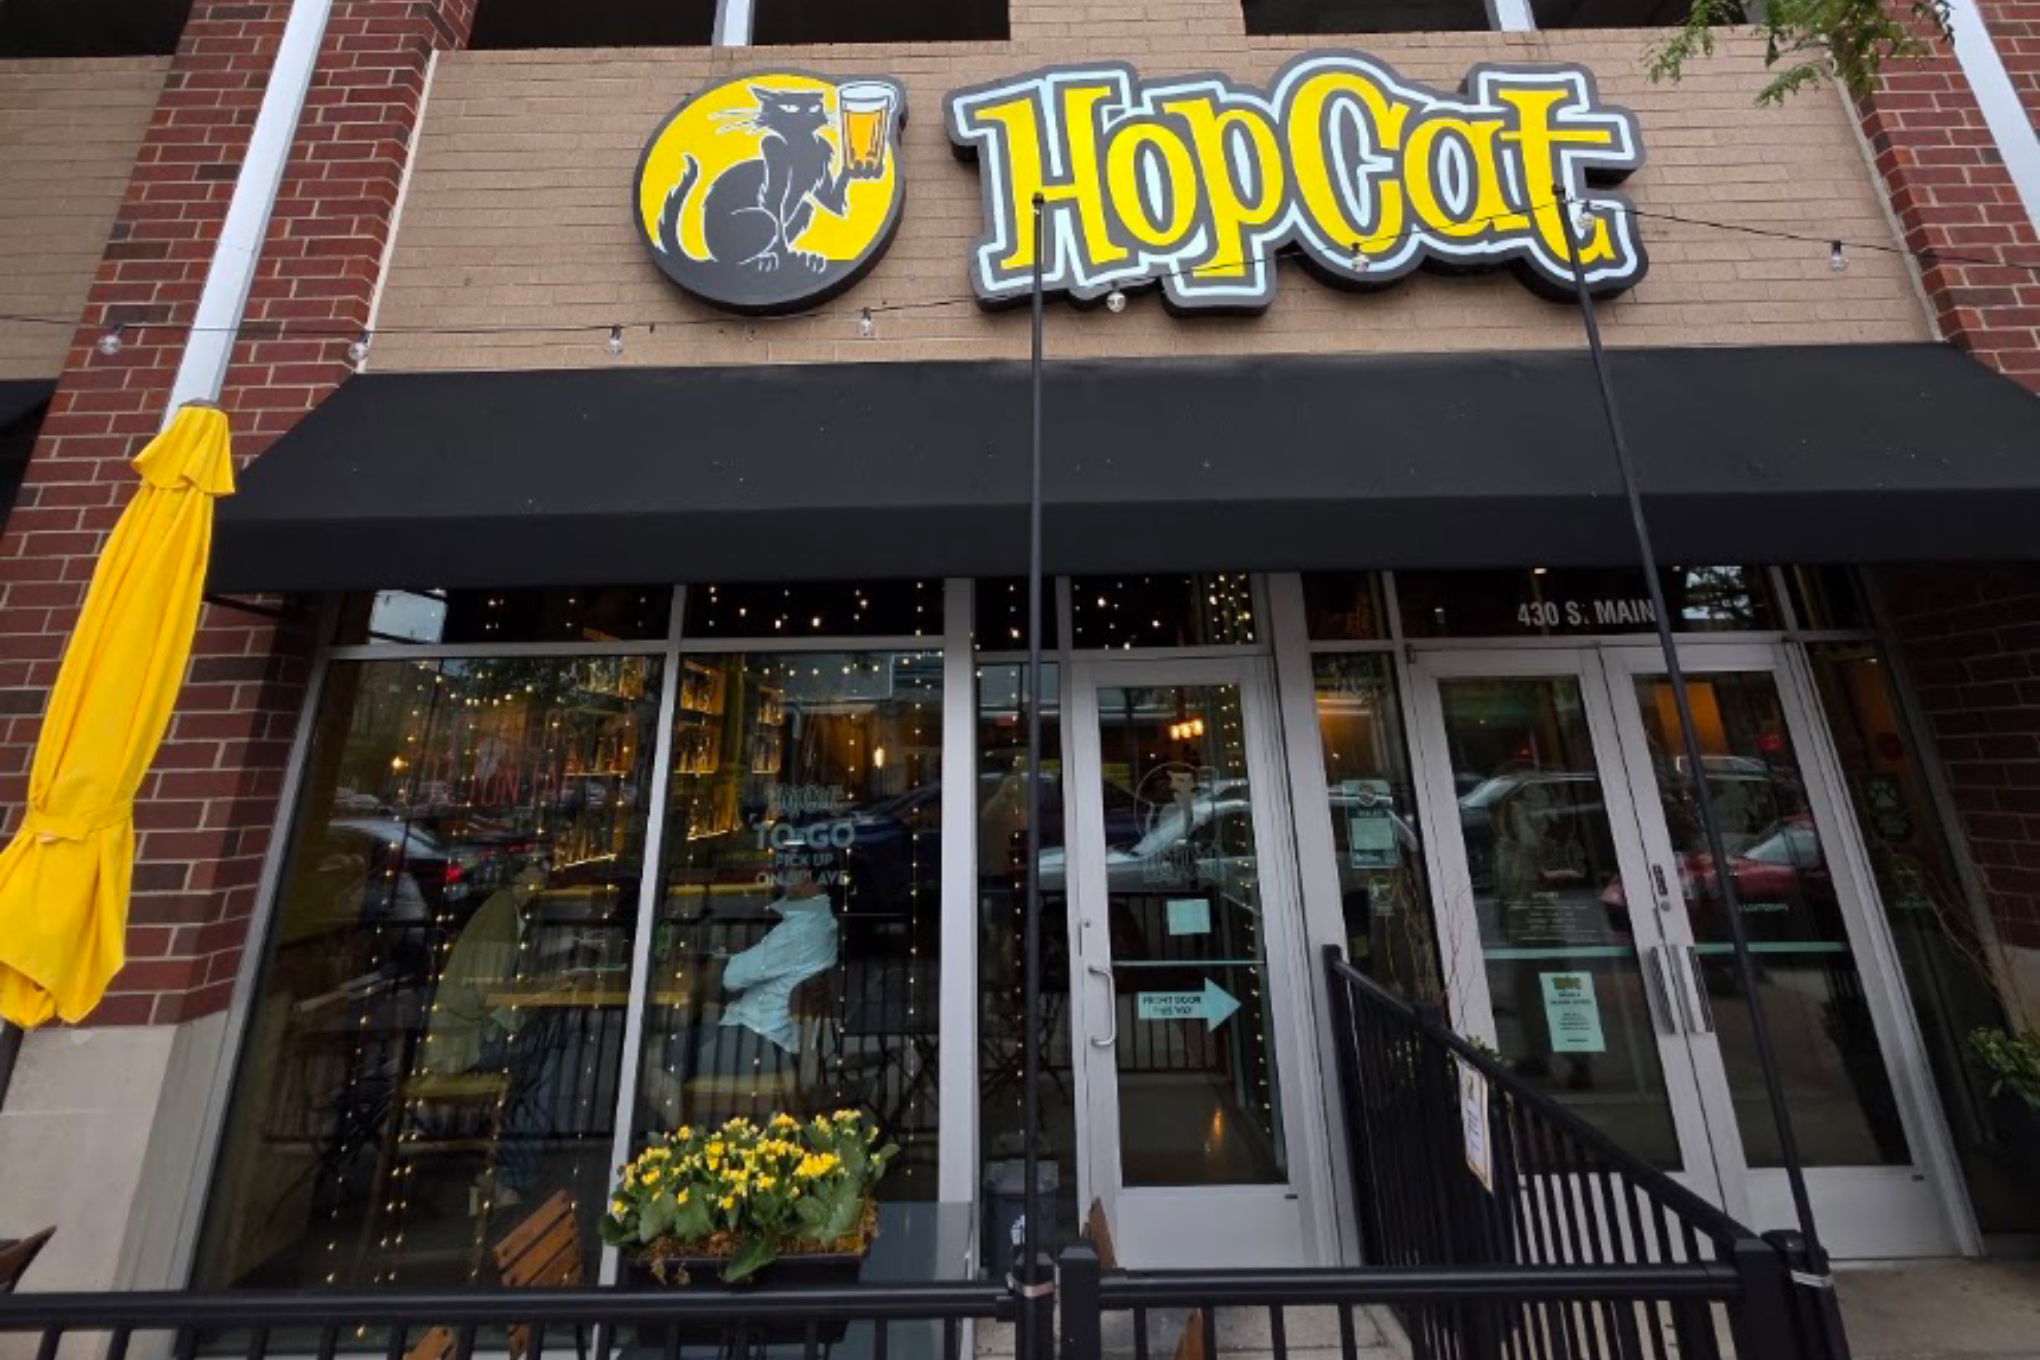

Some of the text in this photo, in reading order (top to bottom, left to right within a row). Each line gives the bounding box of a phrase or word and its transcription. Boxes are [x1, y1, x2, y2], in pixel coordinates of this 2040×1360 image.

[968, 68, 1622, 284] HopCat
[1517, 600, 1559, 627] 430
[1594, 598, 1657, 624] MAIN
[813, 853, 834, 867] UP
